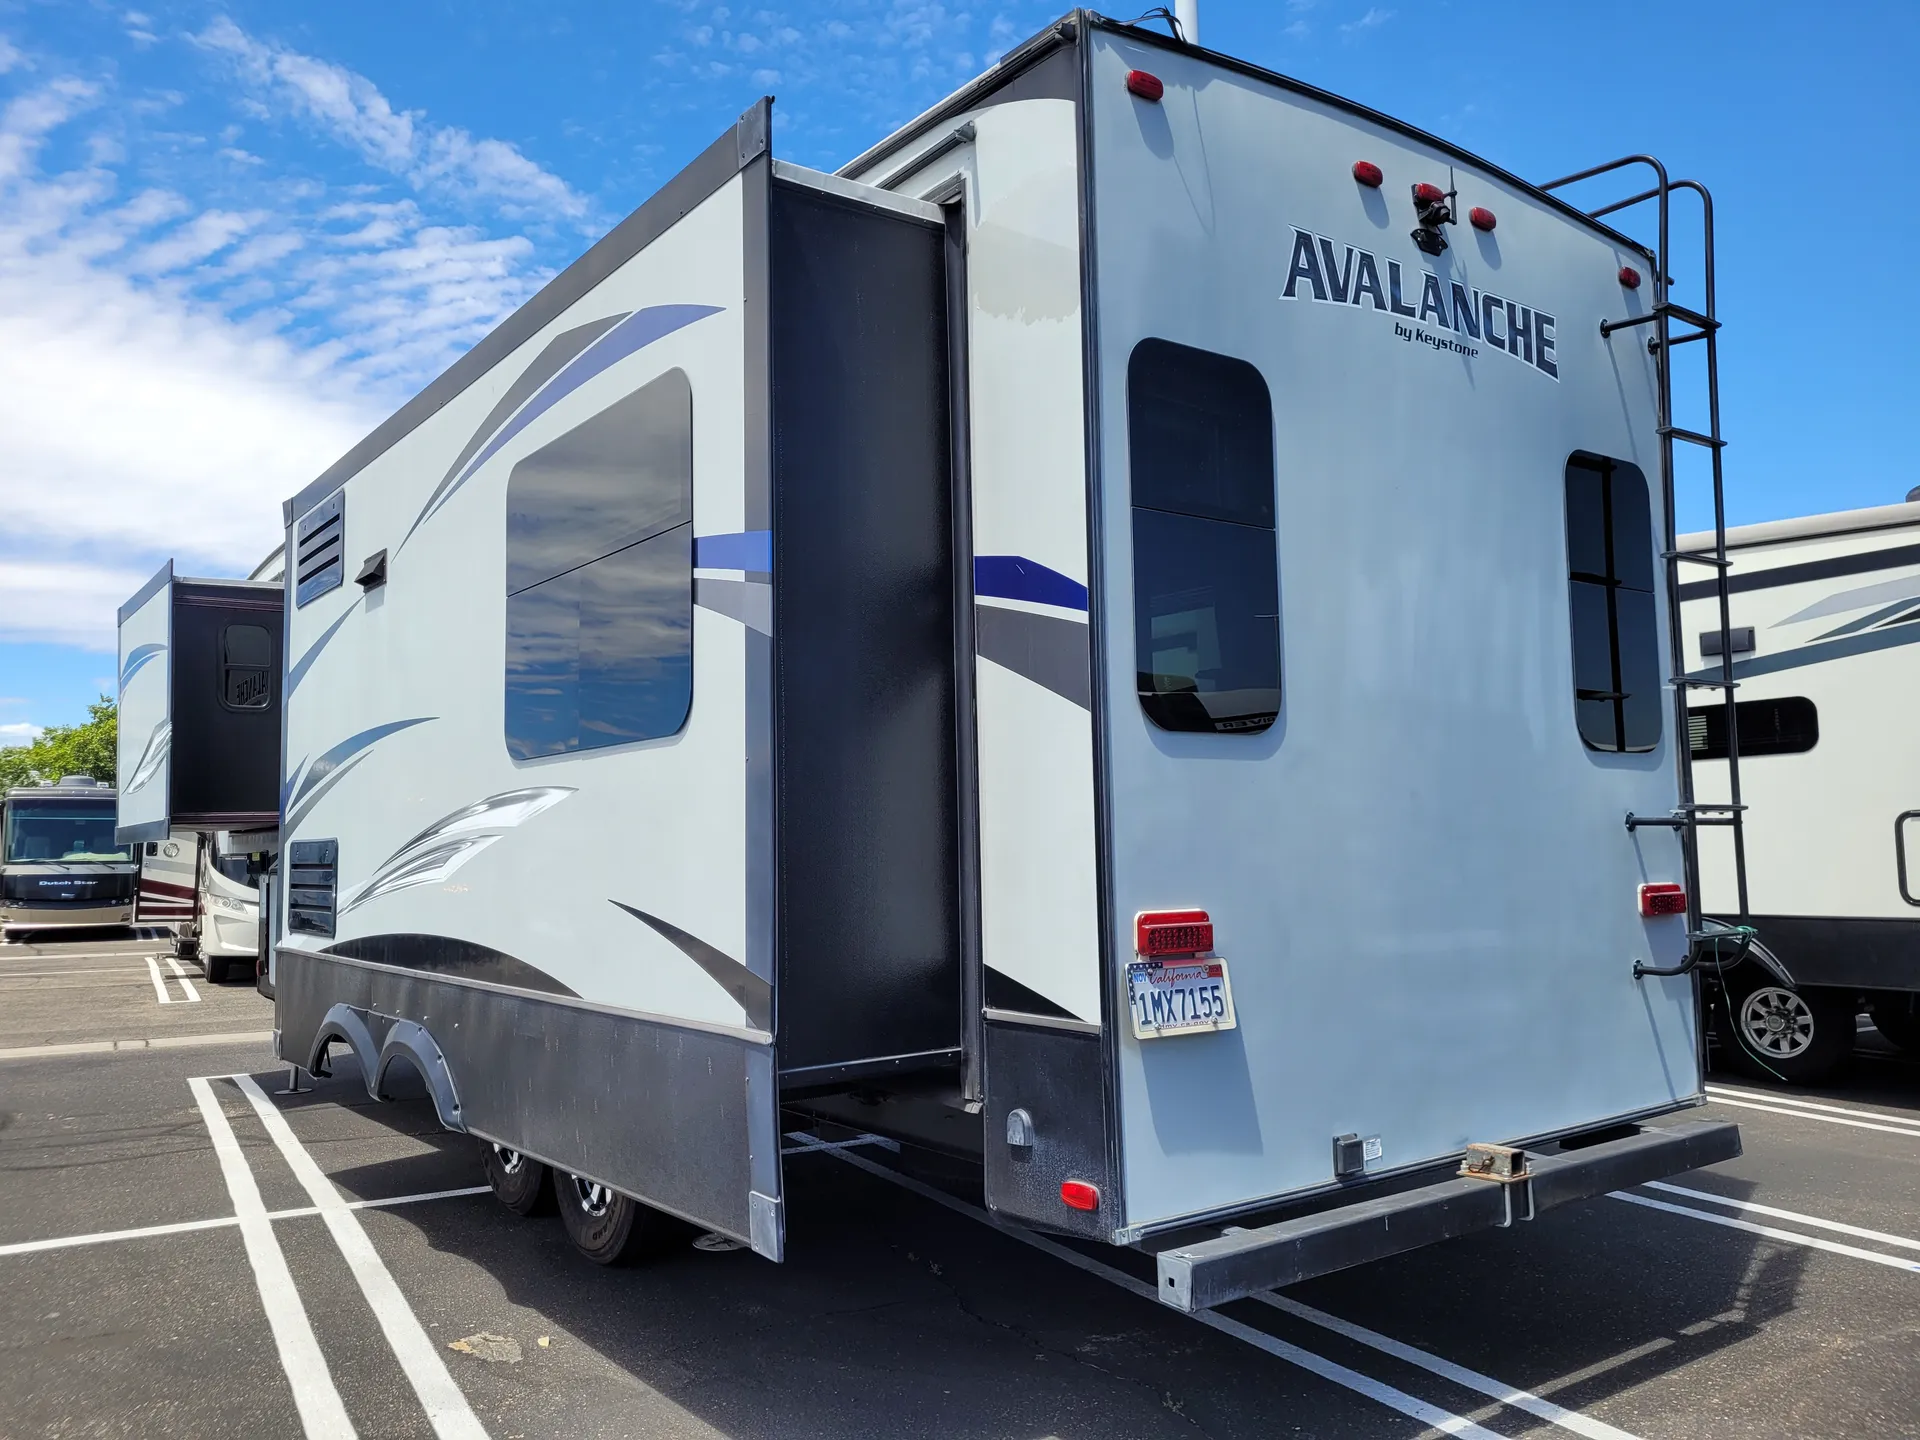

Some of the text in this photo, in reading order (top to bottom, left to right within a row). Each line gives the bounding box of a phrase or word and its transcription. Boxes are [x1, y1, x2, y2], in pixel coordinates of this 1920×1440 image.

[1279, 224, 1560, 383] AVALANCHE
[1394, 322, 1479, 359] by Keystone
[1133, 972, 1147, 983] NOV
[1149, 968, 1210, 987] California
[1138, 985, 1224, 1025] 1MX7155
